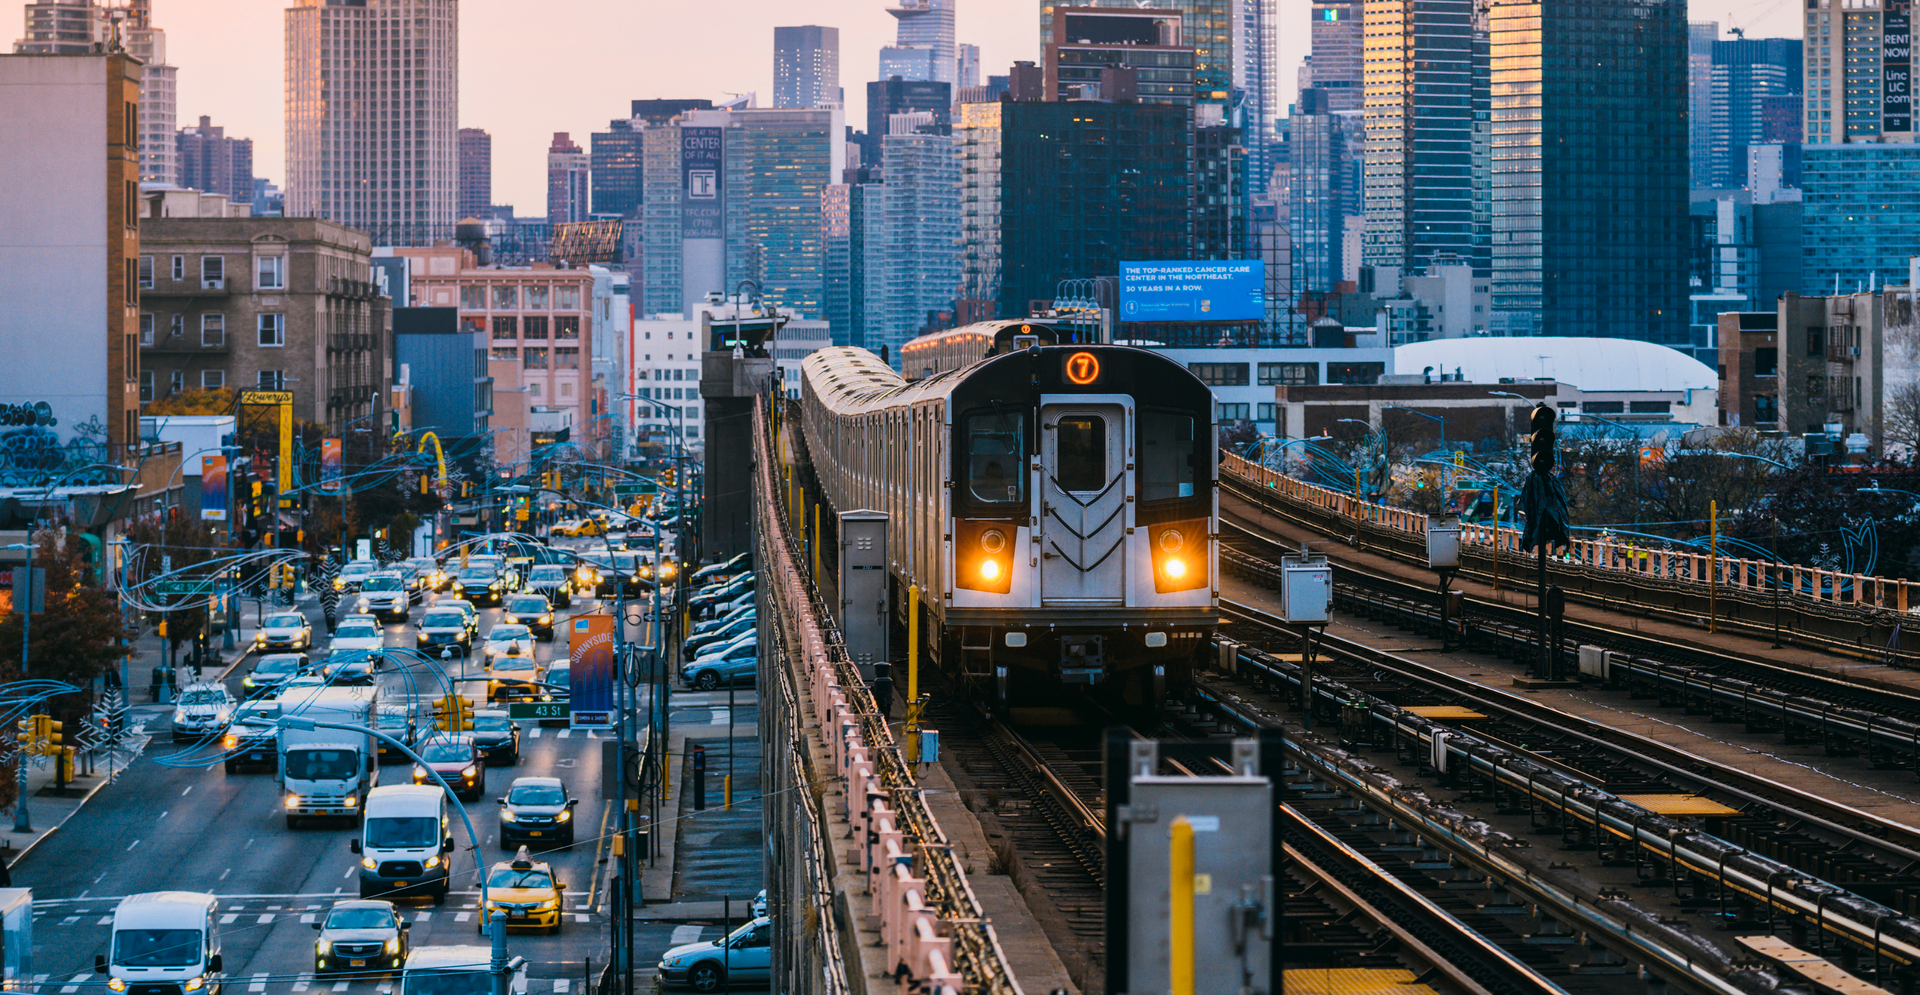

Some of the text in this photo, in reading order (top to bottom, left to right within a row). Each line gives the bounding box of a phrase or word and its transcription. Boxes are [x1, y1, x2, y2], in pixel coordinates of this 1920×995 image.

[1884, 34, 1909, 44] RENT
[1884, 48, 1909, 57] NOW
[1886, 70, 1907, 80] Linc
[1888, 82, 1905, 92] LIC
[1884, 95, 1910, 103] .com
[685, 137, 720, 149] CENTER
[684, 151, 719, 159] OF IT ALL
[1077, 358, 1089, 378] 7
[243, 392, 292, 403] Lowery's
[570, 632, 612, 664] SUNNYSIDE
[535, 705, 561, 716] 43 St
